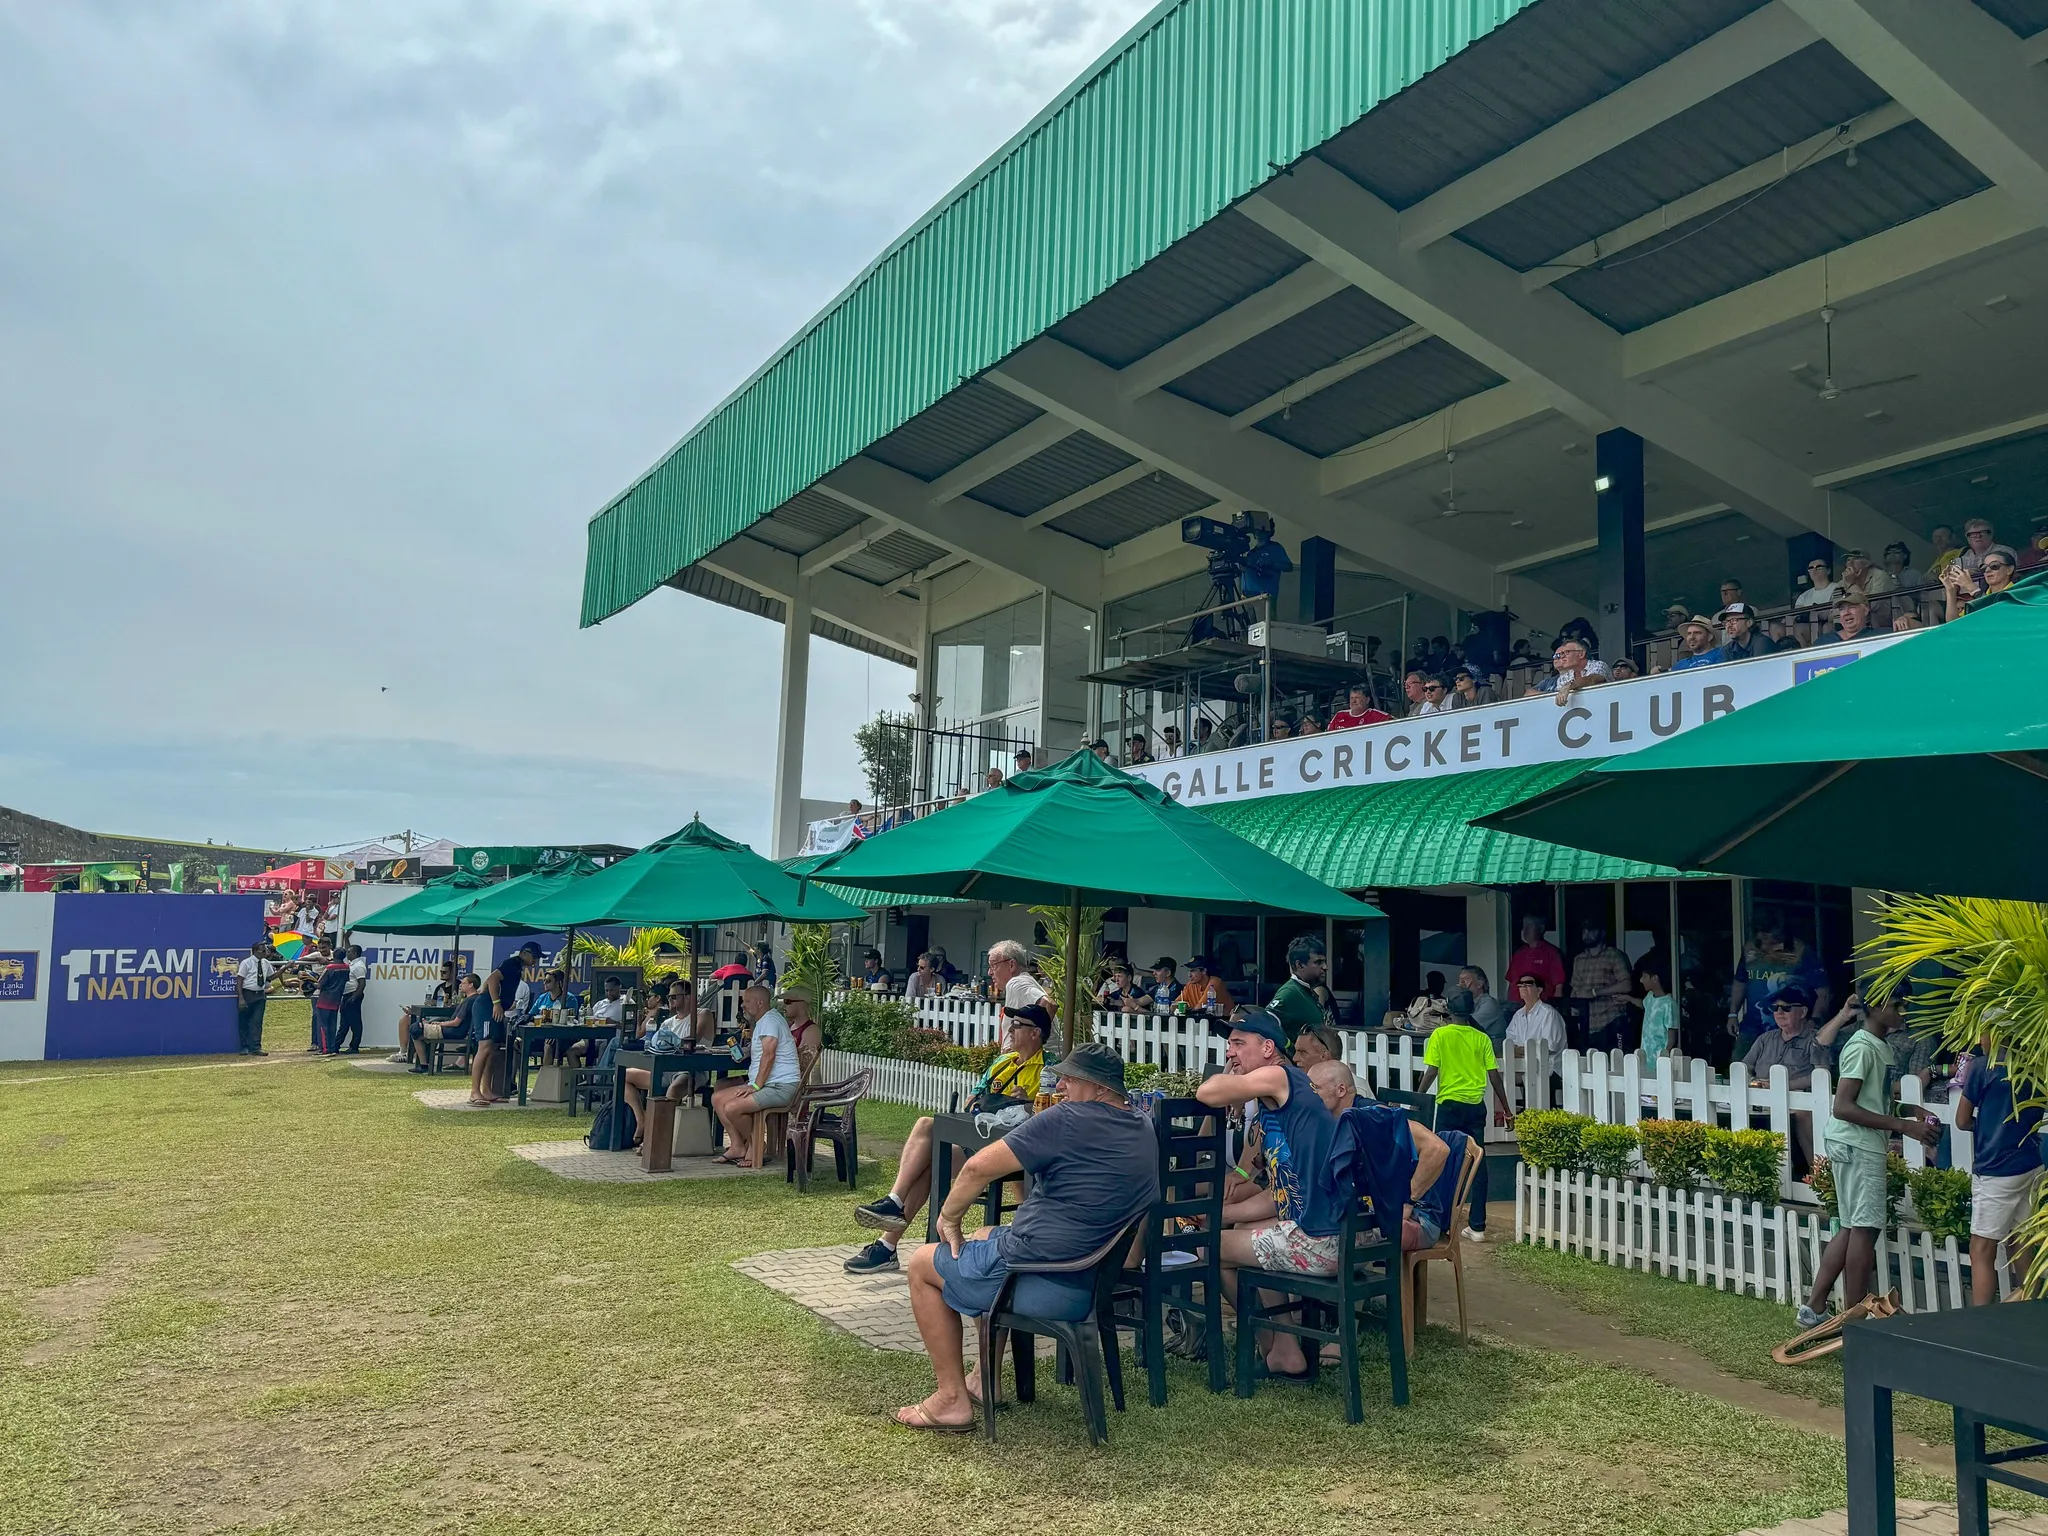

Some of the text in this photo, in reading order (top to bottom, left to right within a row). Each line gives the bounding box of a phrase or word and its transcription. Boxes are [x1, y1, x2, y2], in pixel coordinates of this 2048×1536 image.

[1162, 684, 1736, 801] GALLE CRICKET CLUB
[379, 948, 440, 964] TEAM
[61, 948, 195, 1001] 1 TEAM
[375, 965, 439, 981] NATION
[87, 975, 193, 1001] NATION
[208, 978, 219, 986] Sri
[211, 984, 236, 992] Cricket
